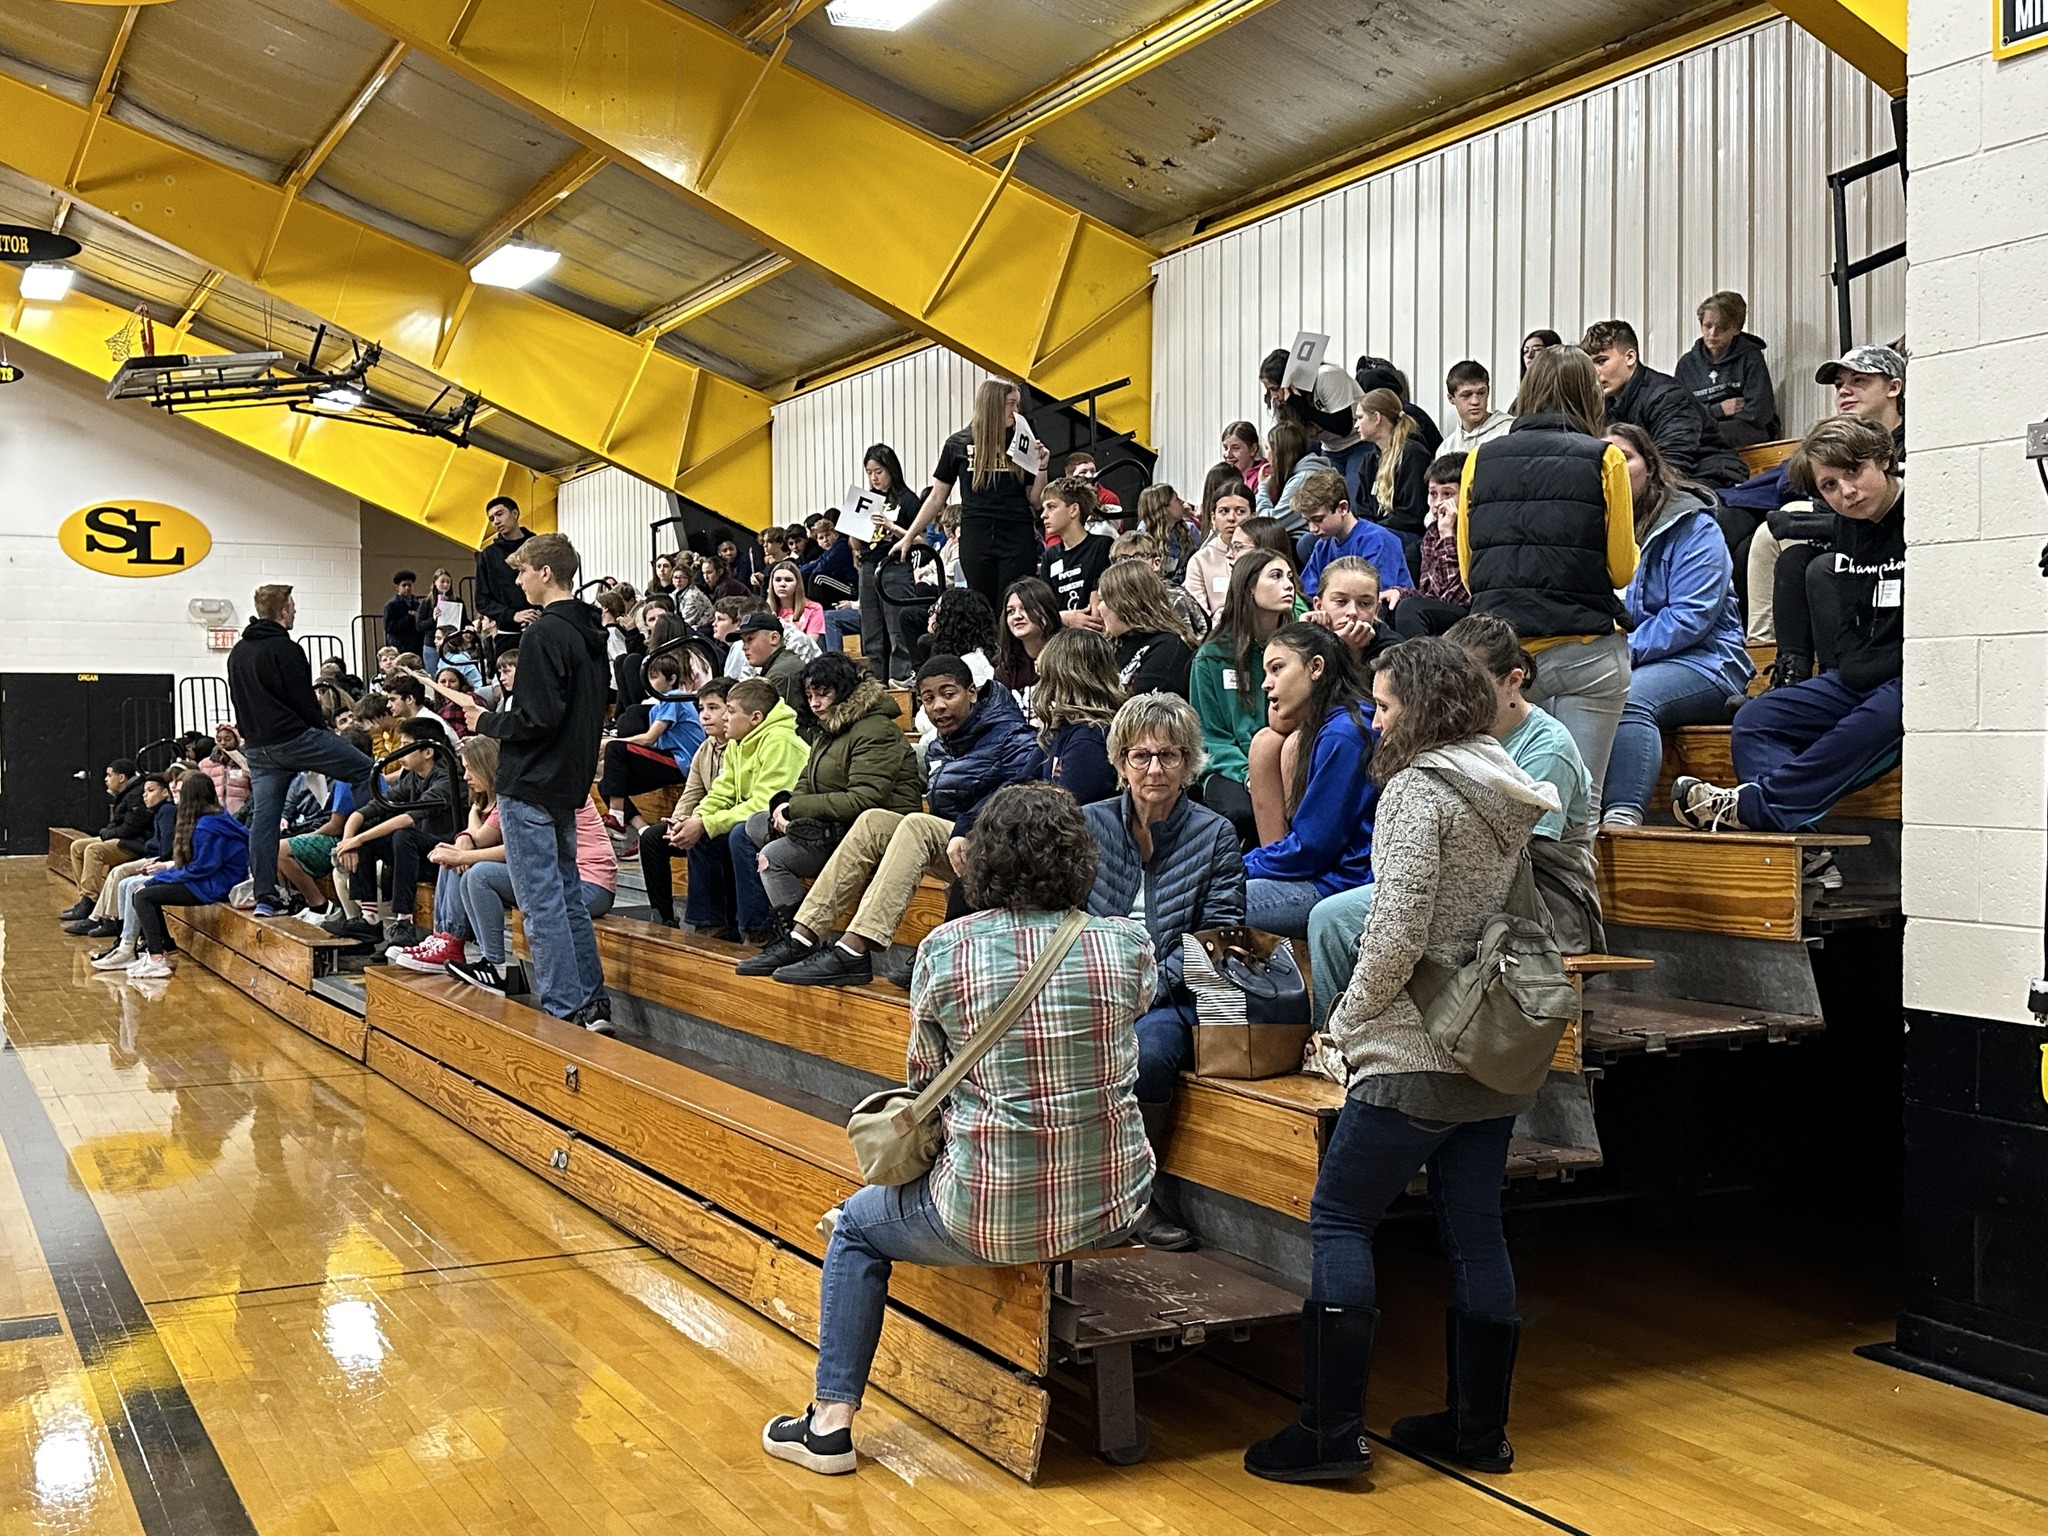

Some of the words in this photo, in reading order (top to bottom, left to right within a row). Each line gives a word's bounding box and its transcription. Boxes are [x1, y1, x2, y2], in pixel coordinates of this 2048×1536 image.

[1018, 433, 1030, 455] B
[855, 495, 873, 513] F
[85, 507, 185, 566] SL
[214, 632, 234, 647] EXIT
